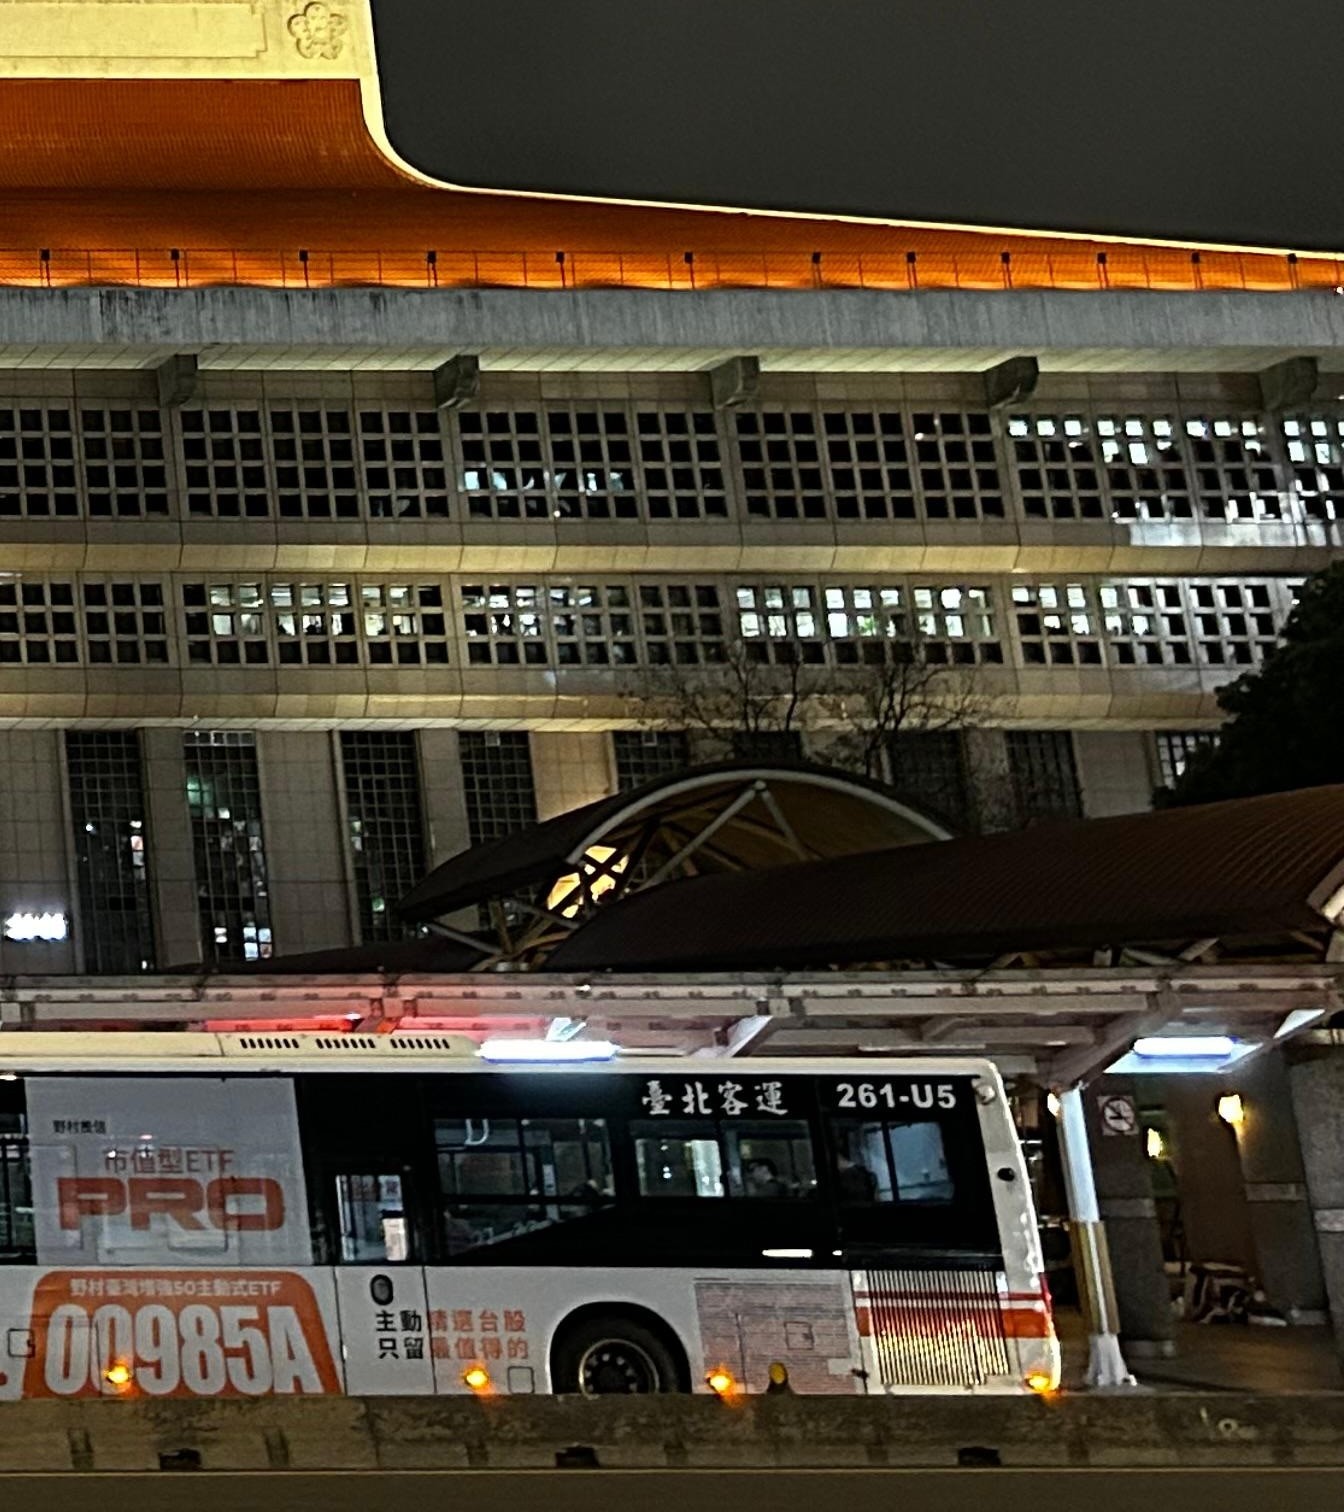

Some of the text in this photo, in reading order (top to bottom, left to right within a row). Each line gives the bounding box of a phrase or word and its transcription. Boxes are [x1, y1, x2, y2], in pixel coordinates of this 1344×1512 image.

[642, 1079, 789, 1115] 臺北客運
[836, 1083, 957, 1109] 261-U5
[102, 1146, 234, 1175] 市值型ETF
[56, 1176, 286, 1231] PRO
[44, 1303, 325, 1395] 00985A
